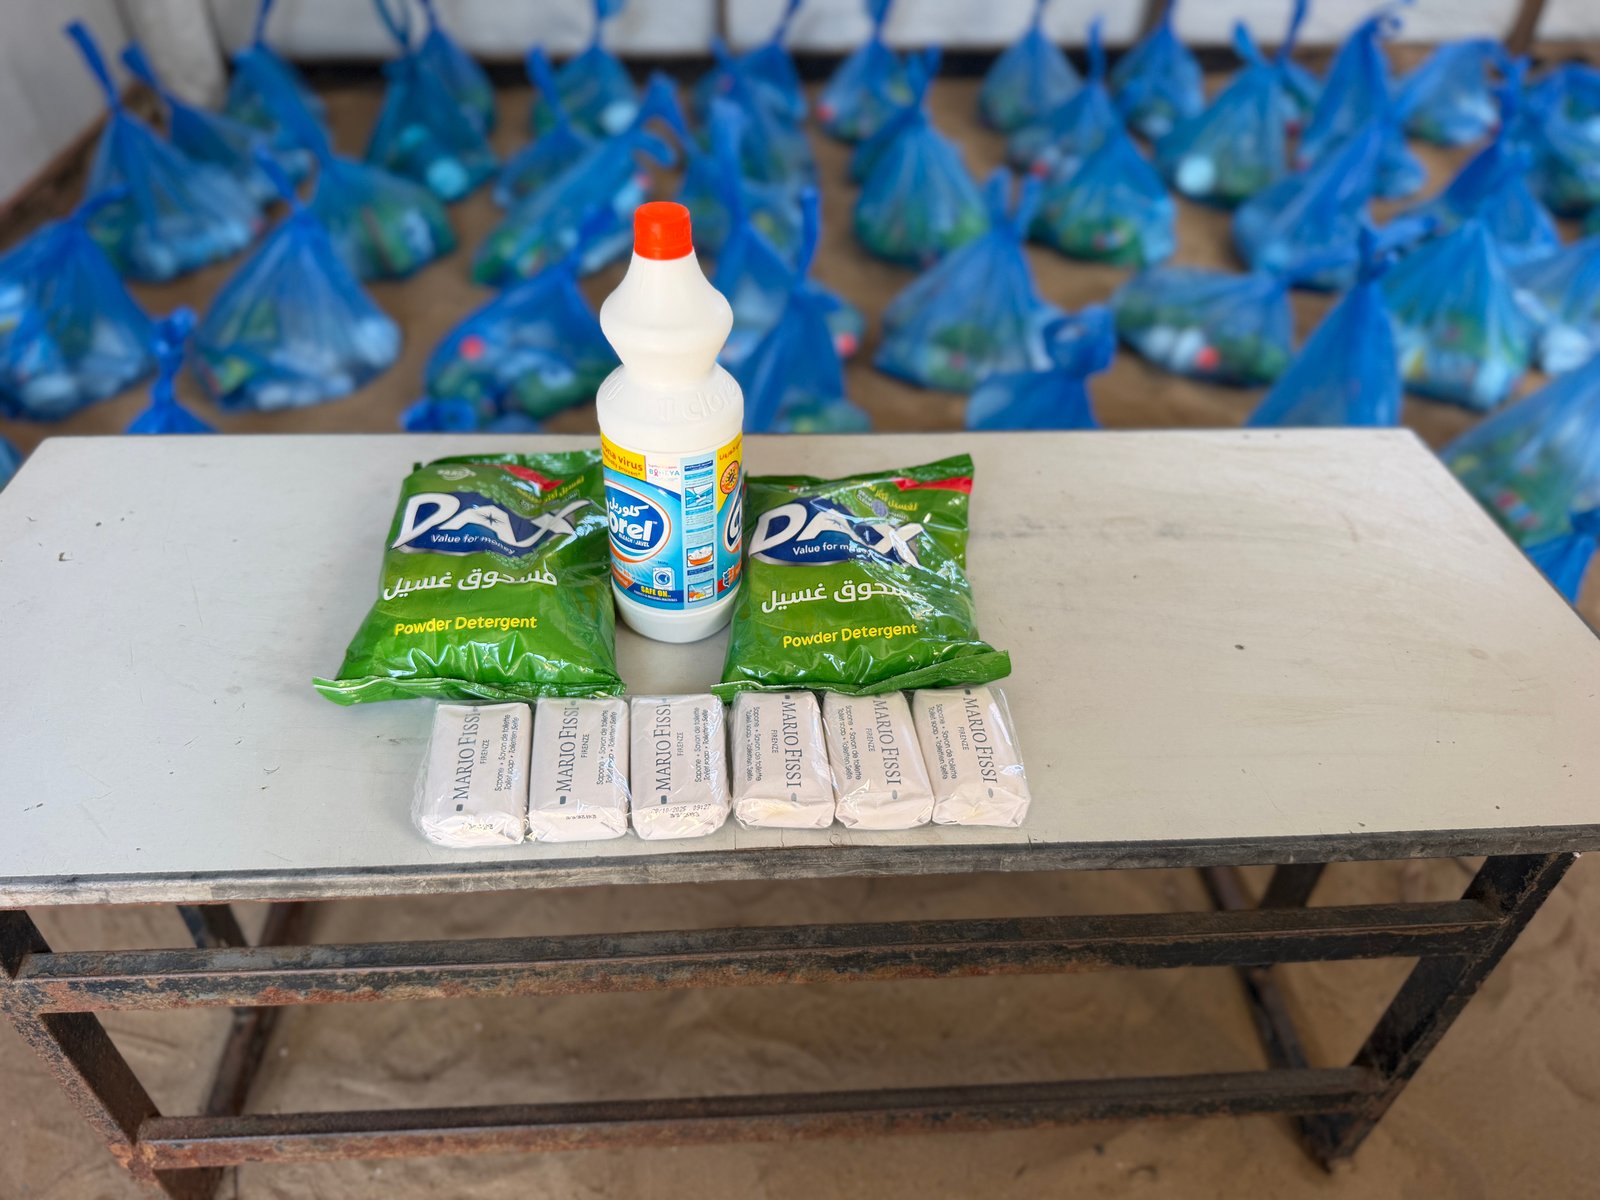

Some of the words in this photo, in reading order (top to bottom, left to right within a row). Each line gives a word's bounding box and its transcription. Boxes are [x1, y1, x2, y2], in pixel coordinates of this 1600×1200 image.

[618, 456, 643, 472] virus
[392, 493, 591, 549] DAX
[432, 534, 460, 544] Value
[464, 534, 479, 542] for
[481, 536, 516, 554] money
[748, 503, 924, 568] DAX
[793, 544, 820, 556] Value
[822, 542, 837, 550] for
[384, 572, 452, 600] غسيل
[458, 568, 558, 591] مسحوق
[641, 586, 656, 596] SAFE
[762, 582, 828, 613] غسيل
[394, 618, 451, 636] Powder
[455, 616, 538, 630] Detergent
[783, 632, 838, 648] Powder
[841, 624, 918, 642] Detergent
[782, 702, 799, 747] MARIO
[873, 700, 894, 744] MARIO
[936, 704, 944, 724] Sapone
[941, 730, 950, 748] Savon
[946, 749, 952, 758] de
[963, 697, 988, 742] MARIO
[501, 733, 508, 742] de
[601, 728, 607, 736] de
[866, 728, 876, 752] FIRENZE
[958, 726, 970, 750] FIRENZE
[480, 740, 490, 764] FIRENZE
[498, 742, 507, 760] Savon
[581, 734, 590, 758] FIRENZE
[598, 736, 606, 754] Savon
[852, 750, 858, 758] de
[453, 748, 475, 800] MARIO
[556, 742, 576, 792] MARIO
[656, 740, 672, 791] MARIO
[495, 768, 504, 791] Sapone
